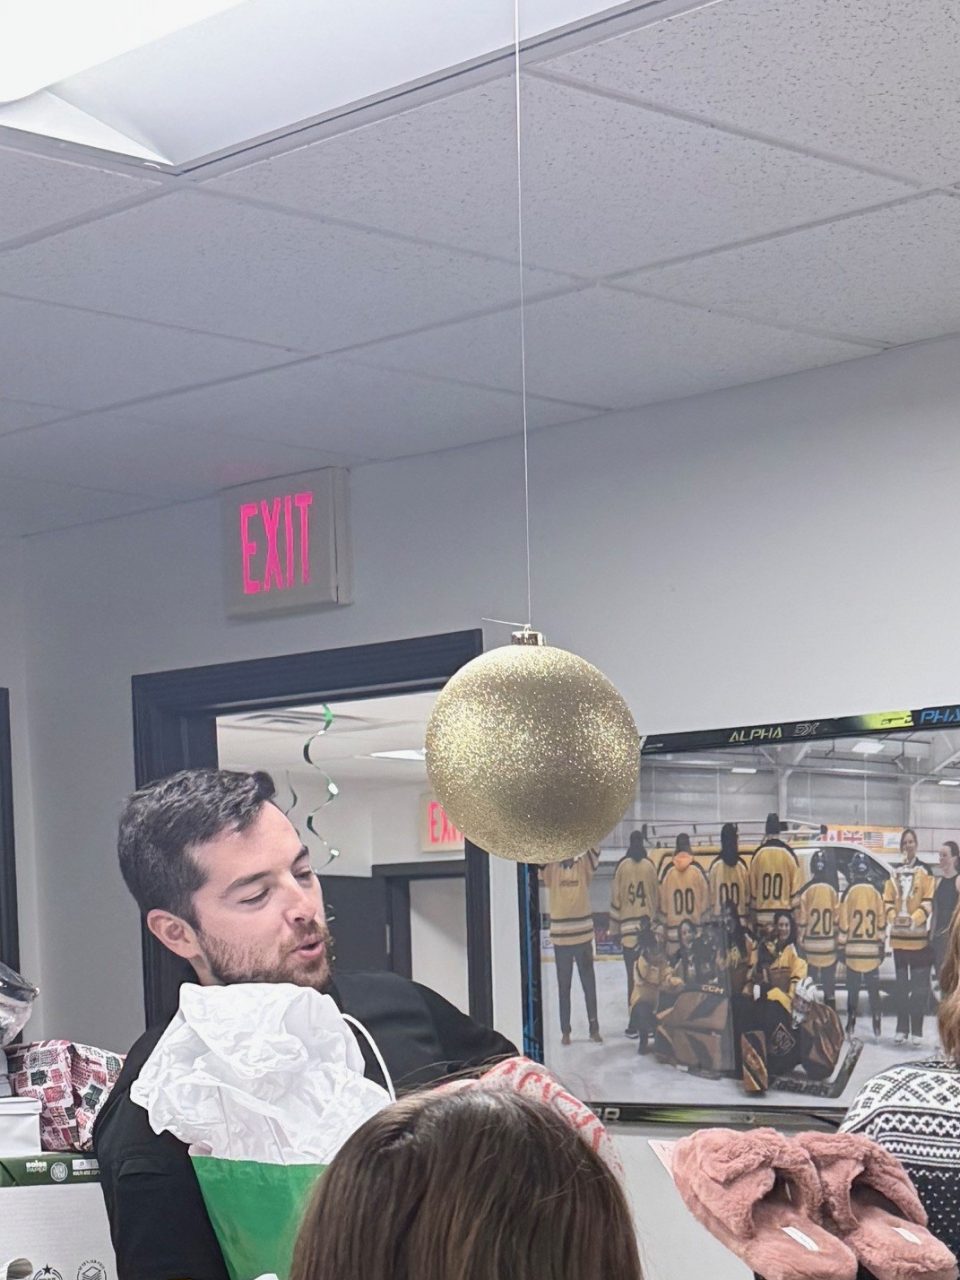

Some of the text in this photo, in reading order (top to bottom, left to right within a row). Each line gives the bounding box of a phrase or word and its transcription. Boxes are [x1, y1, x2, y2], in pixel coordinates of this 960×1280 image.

[240, 491, 313, 594] EXIT
[728, 726, 782, 743] ALPHA
[763, 873, 783, 900] 00
[673, 888, 695, 915] 00
[810, 908, 832, 936] 20
[852, 909, 876, 938] 23
